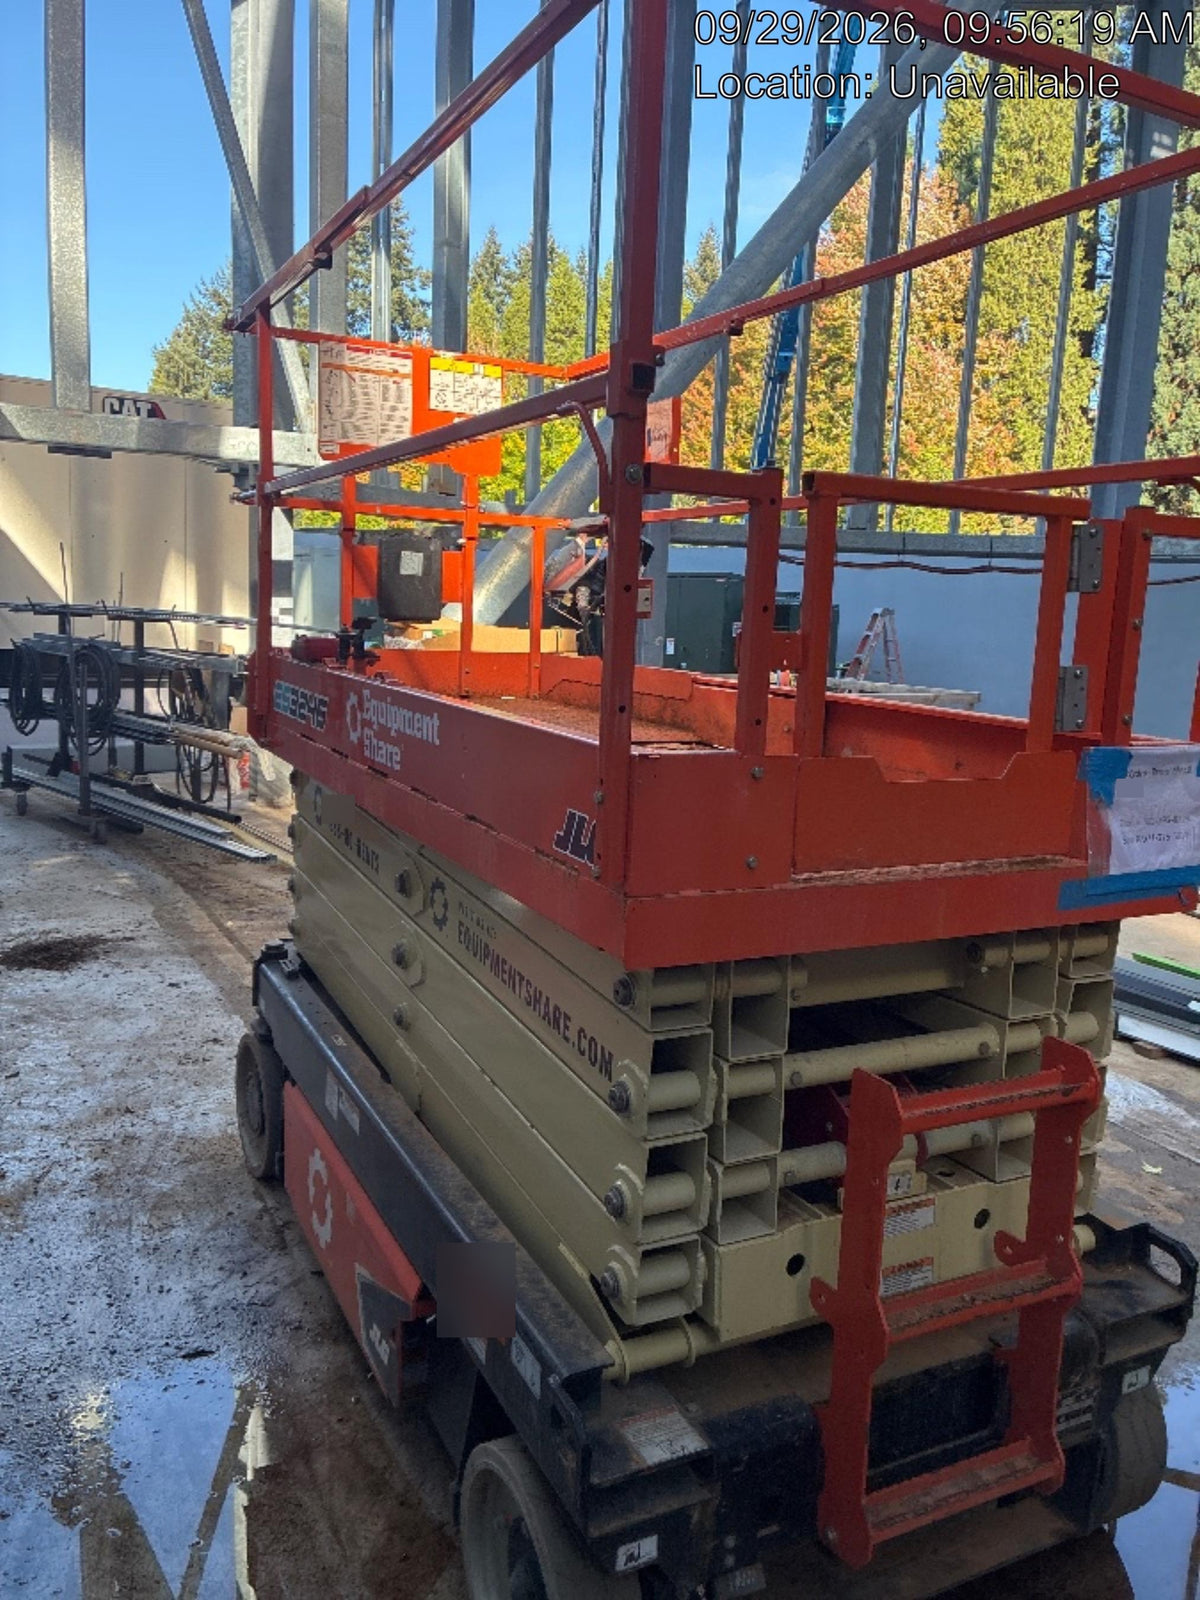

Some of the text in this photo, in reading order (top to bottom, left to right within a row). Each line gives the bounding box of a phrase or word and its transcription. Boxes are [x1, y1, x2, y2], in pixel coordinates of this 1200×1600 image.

[104, 397, 152, 418] CAT
[363, 689, 440, 745] Equipment
[363, 728, 401, 770] Share
[458, 920, 614, 1083] EQUIPMENTSHARE.COM
